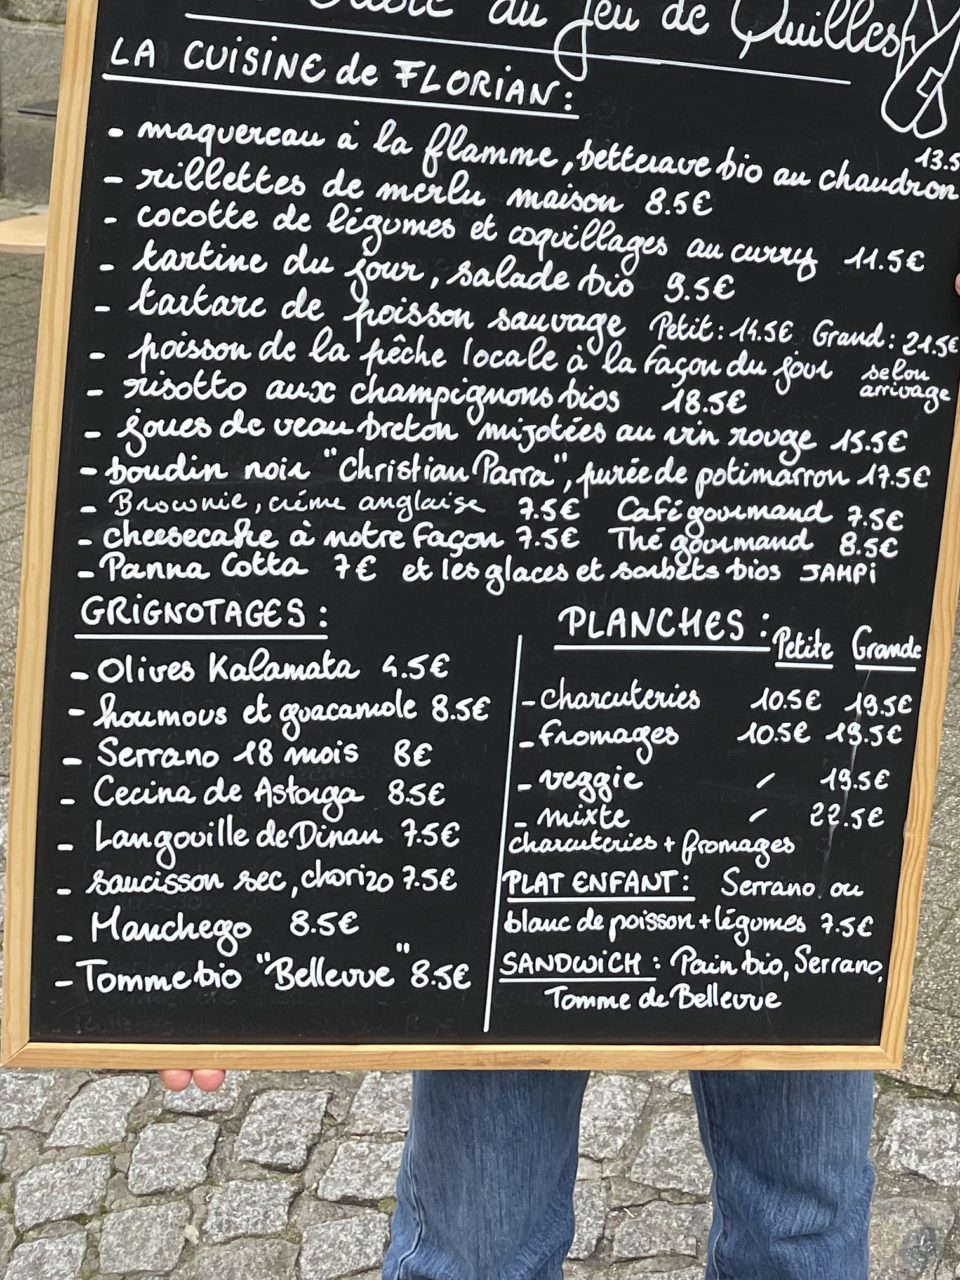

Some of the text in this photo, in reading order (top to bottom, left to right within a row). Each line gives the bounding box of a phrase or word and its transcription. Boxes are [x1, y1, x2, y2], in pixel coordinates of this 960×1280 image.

[111, 37, 155, 67] LA
[336, 51, 378, 86] de
[137, 121, 326, 157] maquereau
[337, 120, 360, 151] à
[373, 119, 414, 157] la
[576, 139, 712, 176] betterave
[716, 146, 763, 183] bio
[774, 168, 810, 188] au
[819, 160, 960, 200] chaudron
[135, 157, 713, 216] rillettes de merlu maison 8.5€
[137, 199, 925, 282] cocotte de légumes et coquillages au curry 11.5€
[133, 240, 268, 273] tartine
[283, 244, 334, 274] du
[446, 254, 570, 292] salade
[578, 263, 635, 298] bio
[663, 275, 735, 303] 9.5€
[129, 278, 959, 356] tartare de poisson sauvage Petit: 14.5€ Grand: 21.5€
[128, 331, 251, 373] poisson
[259, 329, 297, 361] de
[308, 326, 351, 363] la
[359, 334, 447, 375] pêche
[463, 336, 559, 371] locale
[566, 344, 588, 370] à
[602, 345, 636, 374] la
[728, 350, 767, 377] du
[774, 351, 833, 395] jour
[860, 360, 930, 382] selon
[123, 370, 747, 423] risotto aux champignons bios 18.5€
[860, 383, 951, 412] arrivage
[117, 408, 908, 465] joues de veau breton mijotées au vin rouge 15.5€
[97, 647, 450, 684] Olives Kalamata 4.5€
[772, 626, 834, 661] Petite
[852, 626, 921, 660] Grande
[93, 689, 490, 741] houmous et guacamole 8.5€
[540, 678, 912, 716] charcuteries 10.5€ 19.5€
[97, 737, 432, 768] Serrano 18 mois 8€
[538, 719, 903, 764] fromages 10.5€ 19.5€
[93, 775, 446, 821] Cecina de Astorga 8.5€
[539, 765, 889, 802] veggie 19.5€
[537, 803, 885, 828] mixte 22.5€
[86, 868, 225, 895] saucisson
[301, 859, 394, 892] chorizo
[401, 868, 457, 891] 7.5€
[502, 872, 566, 894] PLAT
[720, 867, 816, 897] Serrano
[830, 881, 864, 897] ou
[90, 905, 359, 957] Manchego 8.5€
[544, 982, 782, 1010] Tomme de Bellevue
